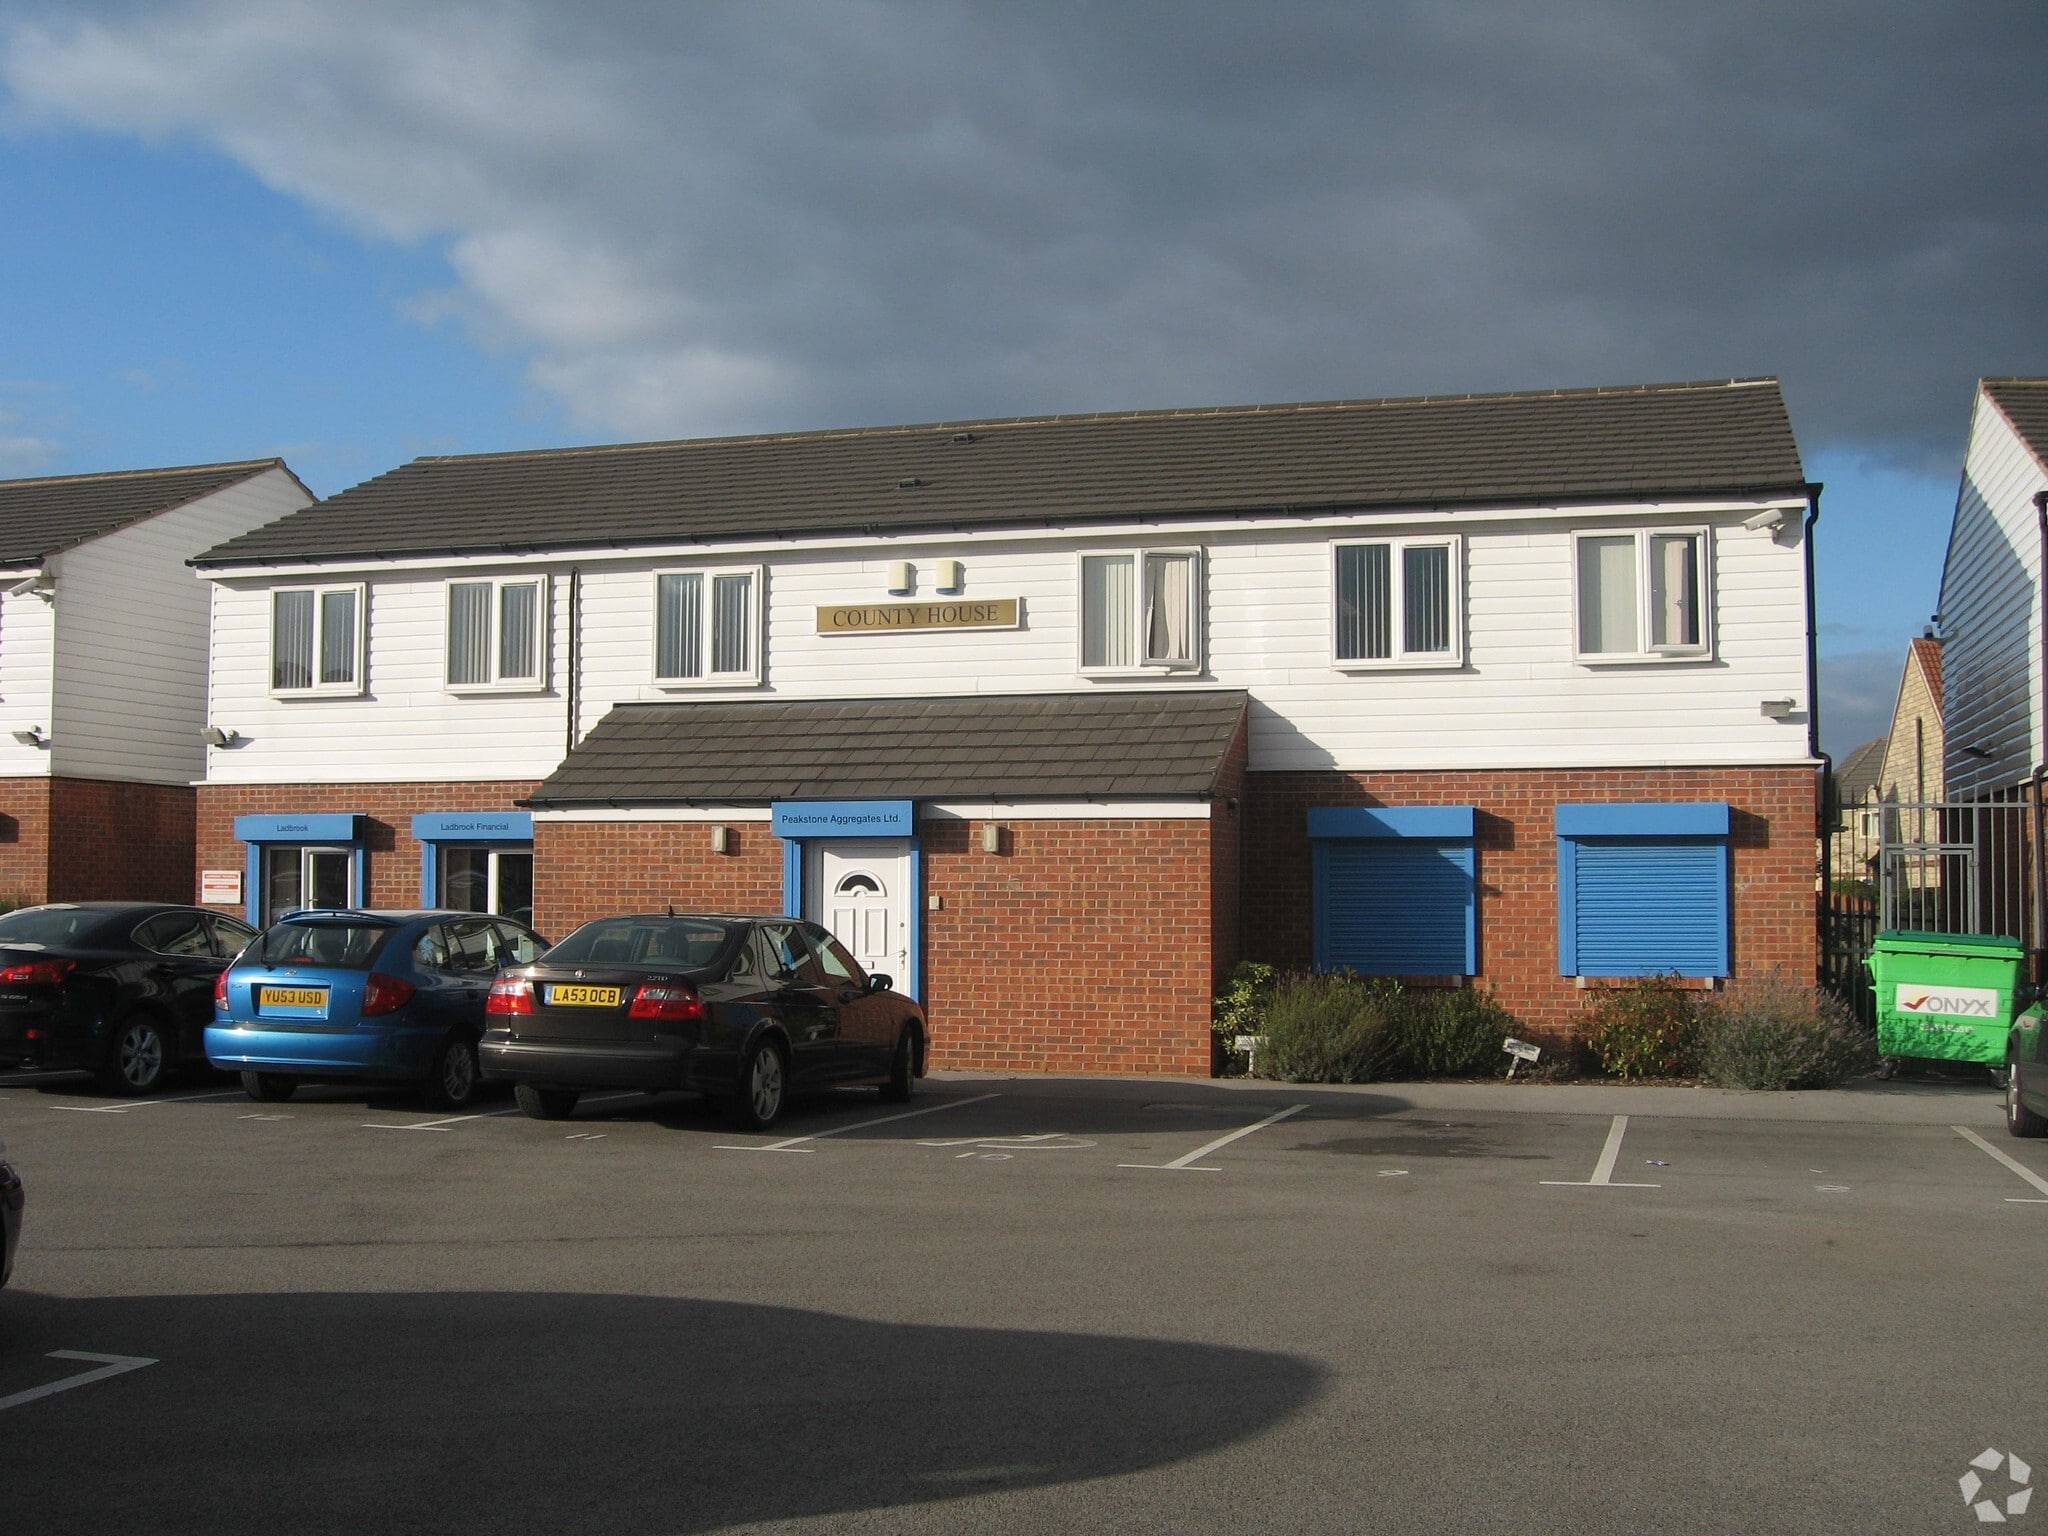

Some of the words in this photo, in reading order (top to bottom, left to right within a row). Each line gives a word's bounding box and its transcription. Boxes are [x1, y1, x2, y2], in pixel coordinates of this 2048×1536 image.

[833, 607, 920, 627] COUNTY
[927, 604, 999, 623] HOUSE
[440, 823, 475, 831] Ladbrook
[476, 822, 509, 831] Financial
[781, 814, 829, 824] Peakstone
[830, 814, 881, 825] Aggregates
[883, 814, 901, 823] Ltd.
[276, 824, 309, 832] Ladbrook
[264, 989, 296, 1003] YU53
[298, 991, 322, 1005] USD
[553, 987, 588, 1002] LA53
[589, 989, 617, 1003] OCB
[1926, 996, 1991, 1016] ONYX
